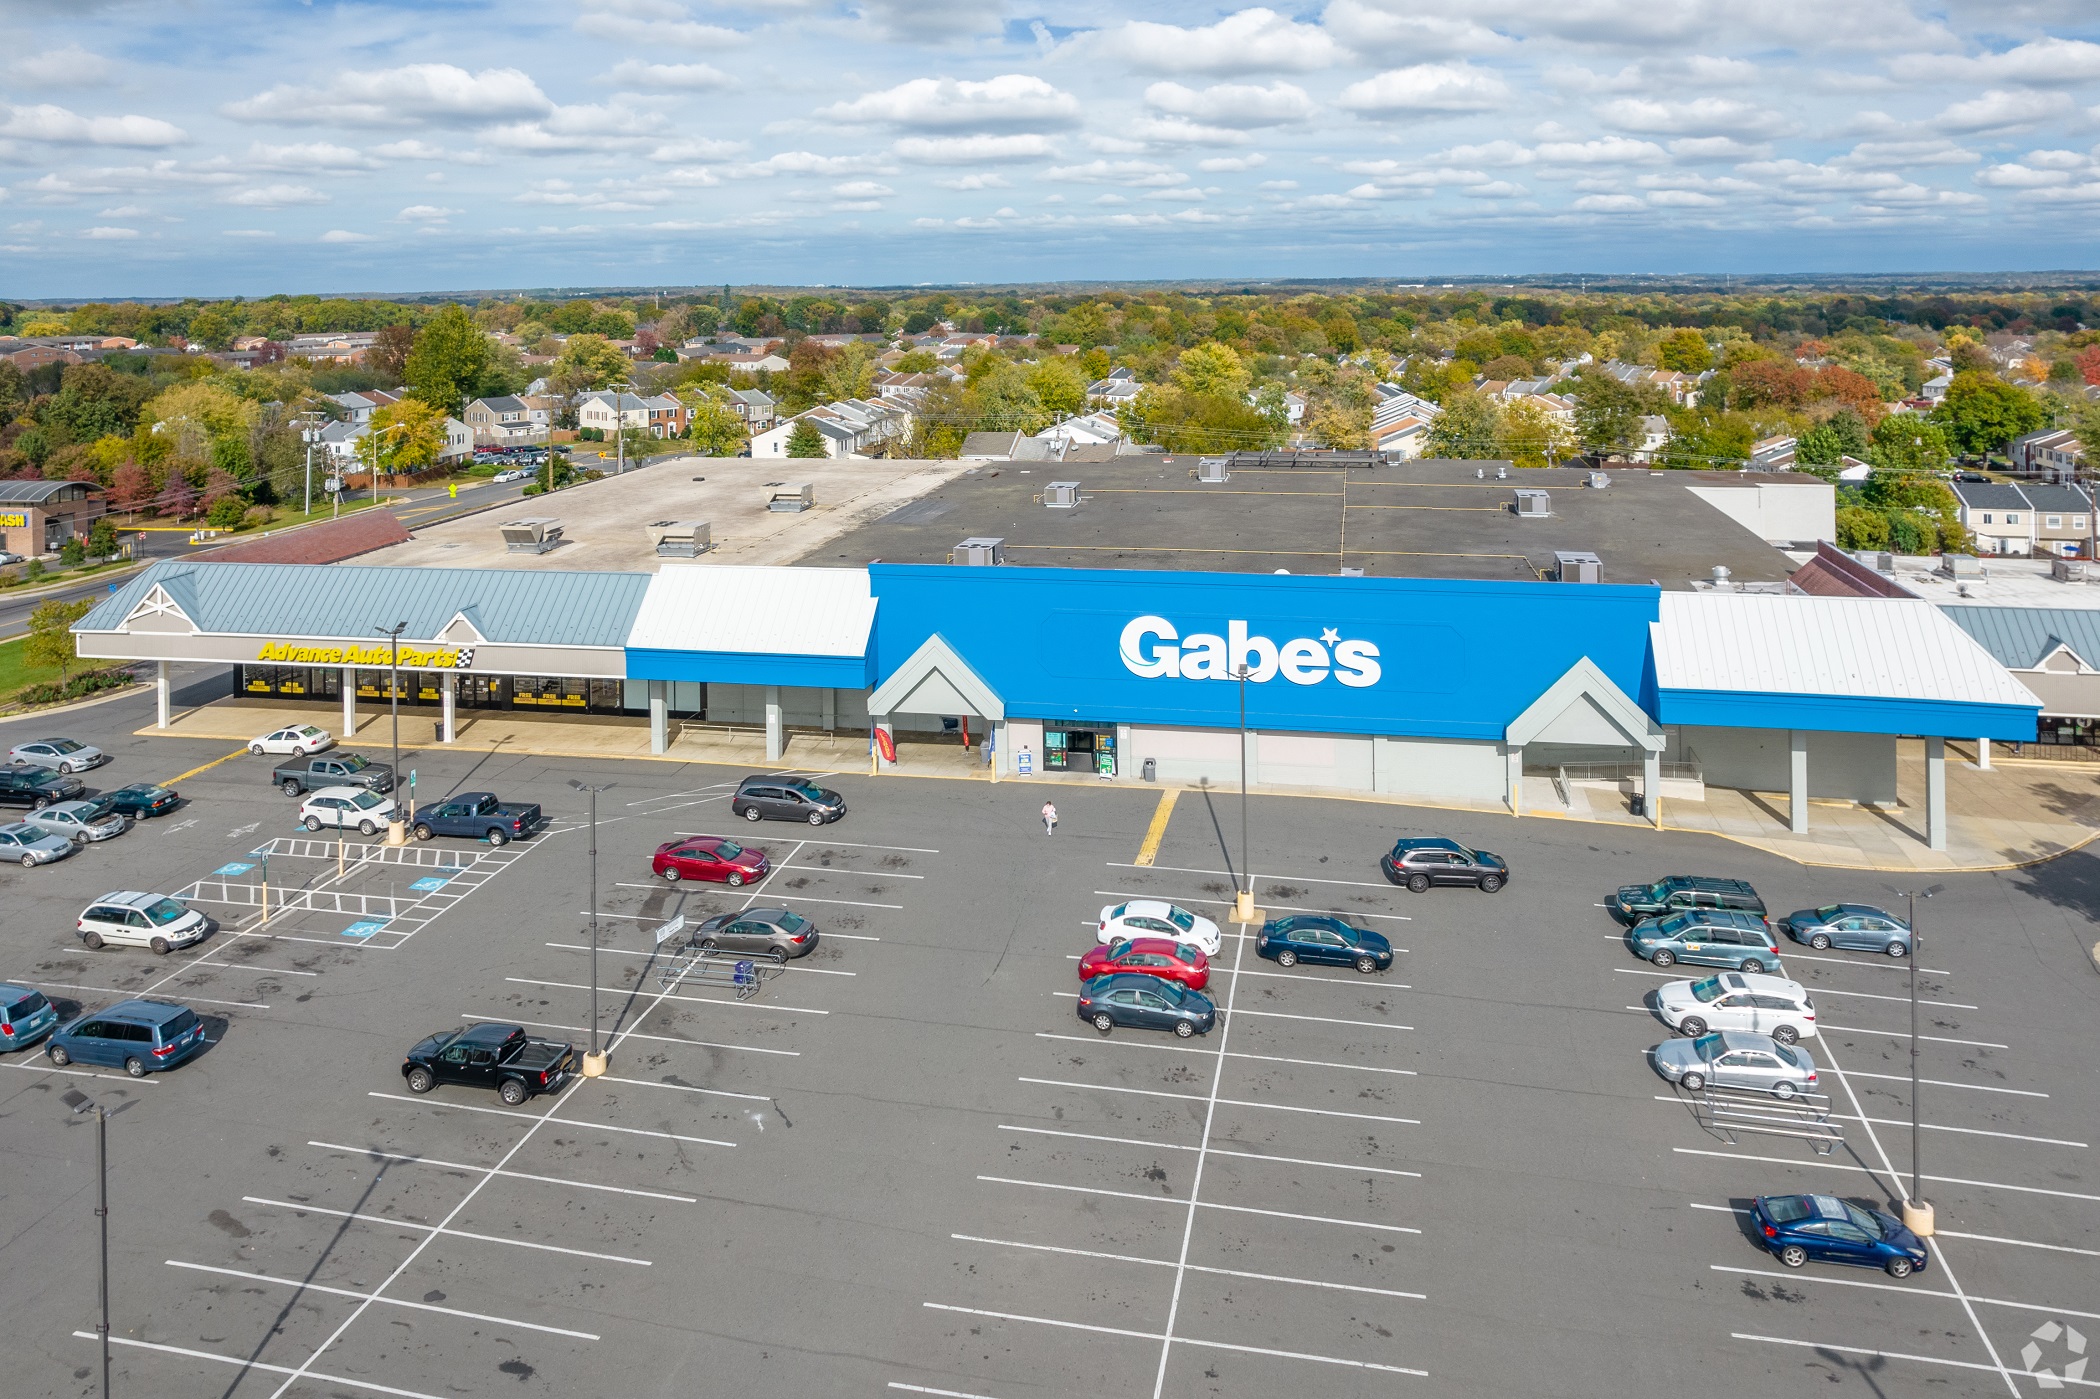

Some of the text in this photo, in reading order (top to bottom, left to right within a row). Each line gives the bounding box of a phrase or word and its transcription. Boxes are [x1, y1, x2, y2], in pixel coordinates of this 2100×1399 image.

[257, 641, 454, 668] Advance Auto Parts
[1119, 615, 1381, 687] Gabe's
